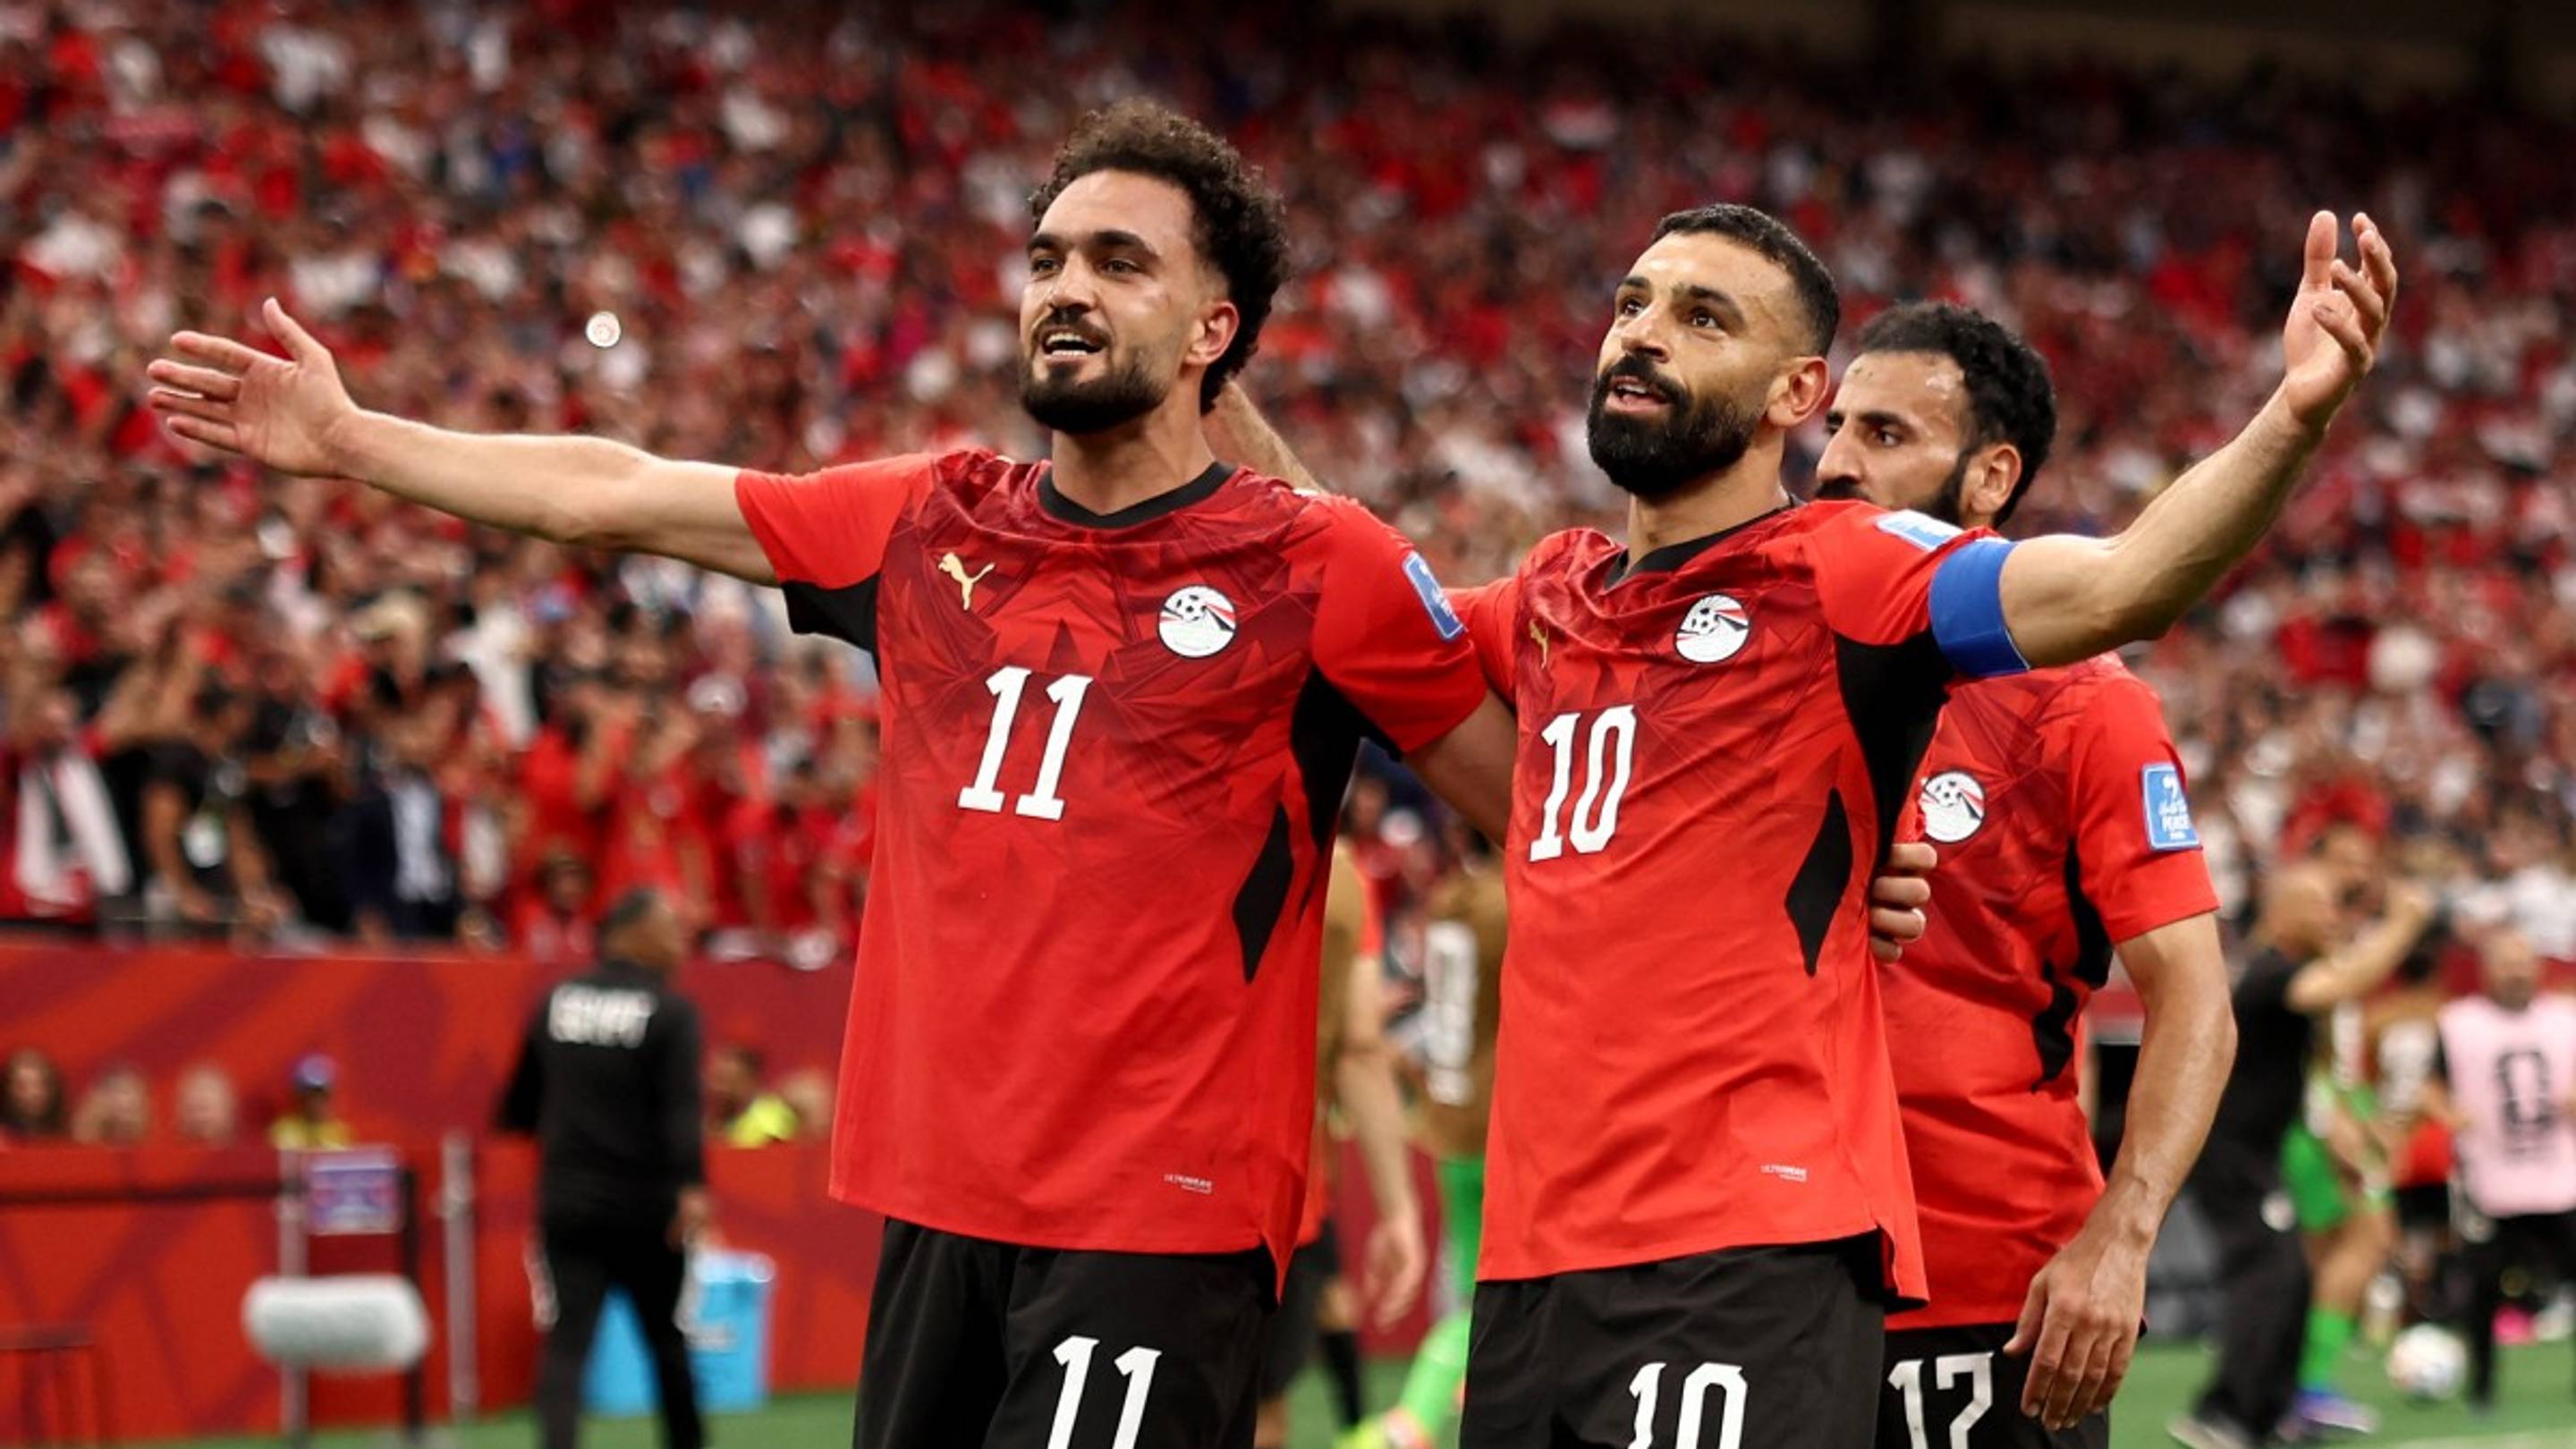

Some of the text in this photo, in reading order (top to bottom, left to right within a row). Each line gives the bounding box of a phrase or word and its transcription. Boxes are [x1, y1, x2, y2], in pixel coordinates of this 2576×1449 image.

[958, 665, 1095, 821] 11
[1530, 704, 1638, 862] 10
[1047, 1335, 1163, 1449] 11
[1628, 1361, 1749, 1449] 10
[1887, 1351, 1996, 1449] 17
